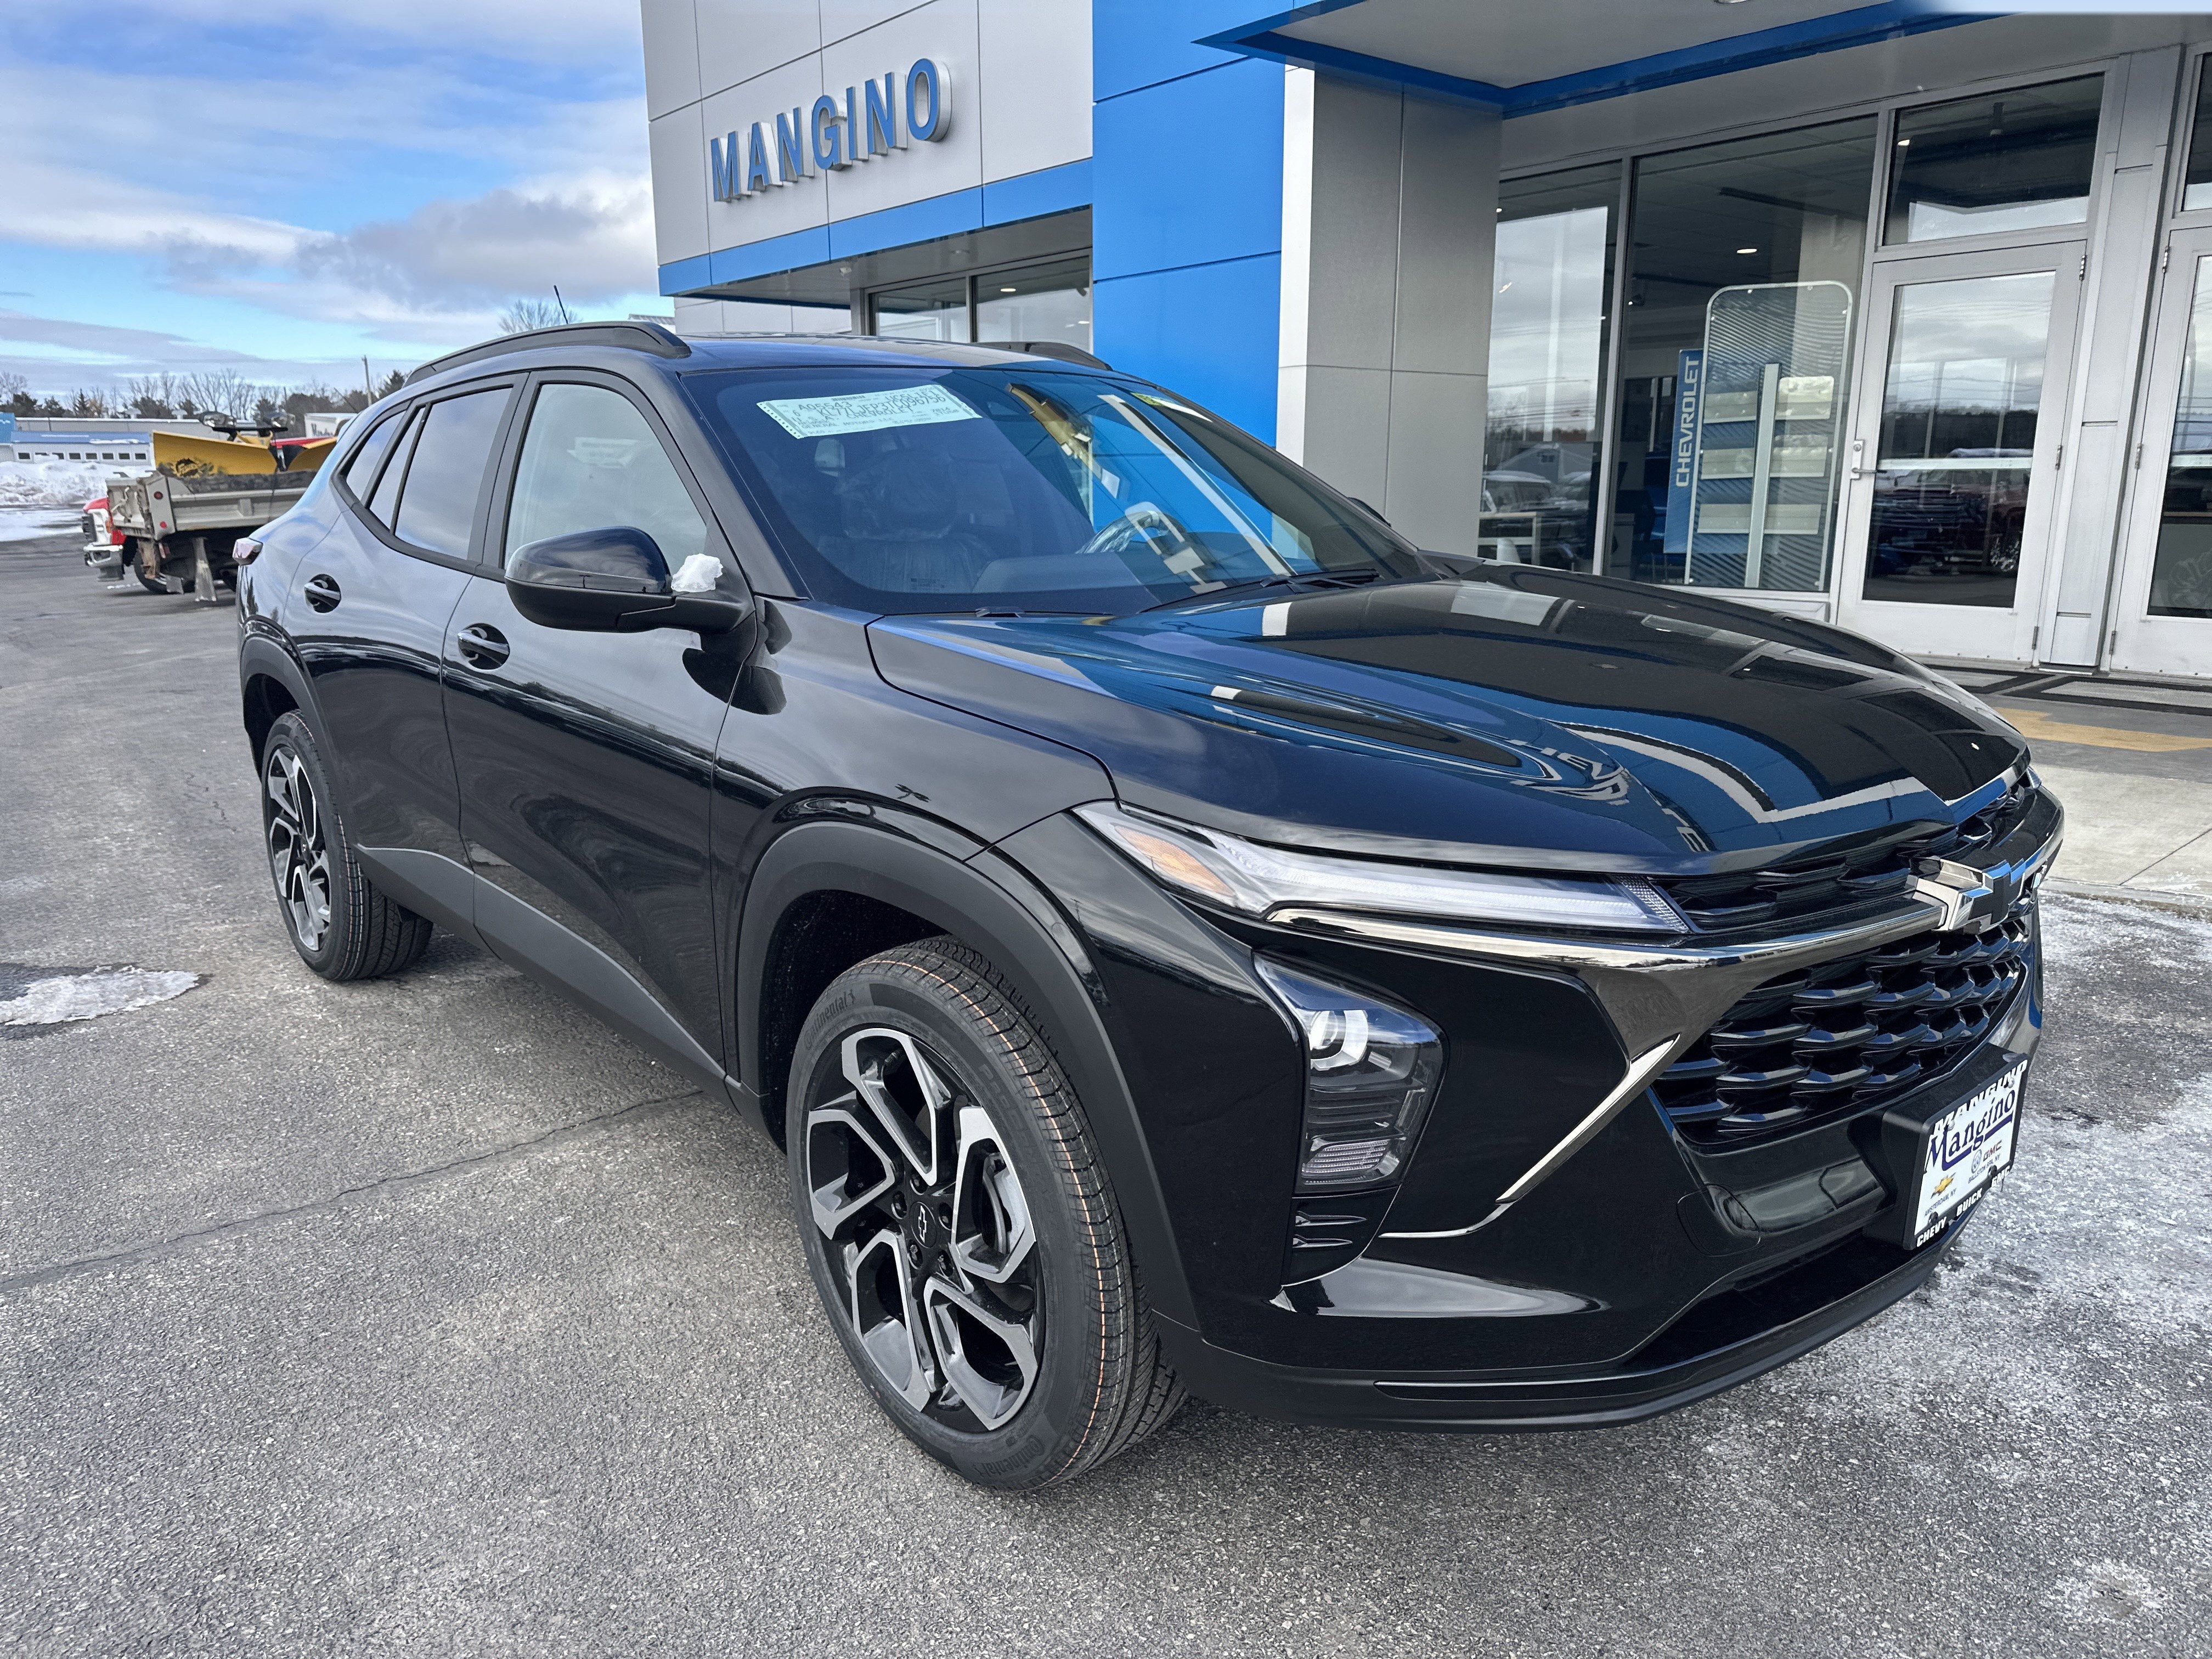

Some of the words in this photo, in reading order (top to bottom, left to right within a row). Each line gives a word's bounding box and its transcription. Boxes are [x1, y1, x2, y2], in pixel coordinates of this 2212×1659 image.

[710, 58, 946, 202] MANGINO
[799, 401, 853, 410] A05543
[845, 406, 913, 418] CHEVROLET
[1675, 356, 1700, 487] CHEVROLET
[1933, 1059, 2028, 1135] MANGINO
[1924, 1090, 2015, 1171] Mangino
[1983, 1140, 2002, 1161] GMC
[1995, 1153, 2000, 1161] NY
[1916, 1217, 1946, 1247] CHEVY
[1956, 1188, 1983, 1216] BUICK
[1991, 1165, 2010, 1187] GMC
[1950, 1188, 1956, 1197] NY
